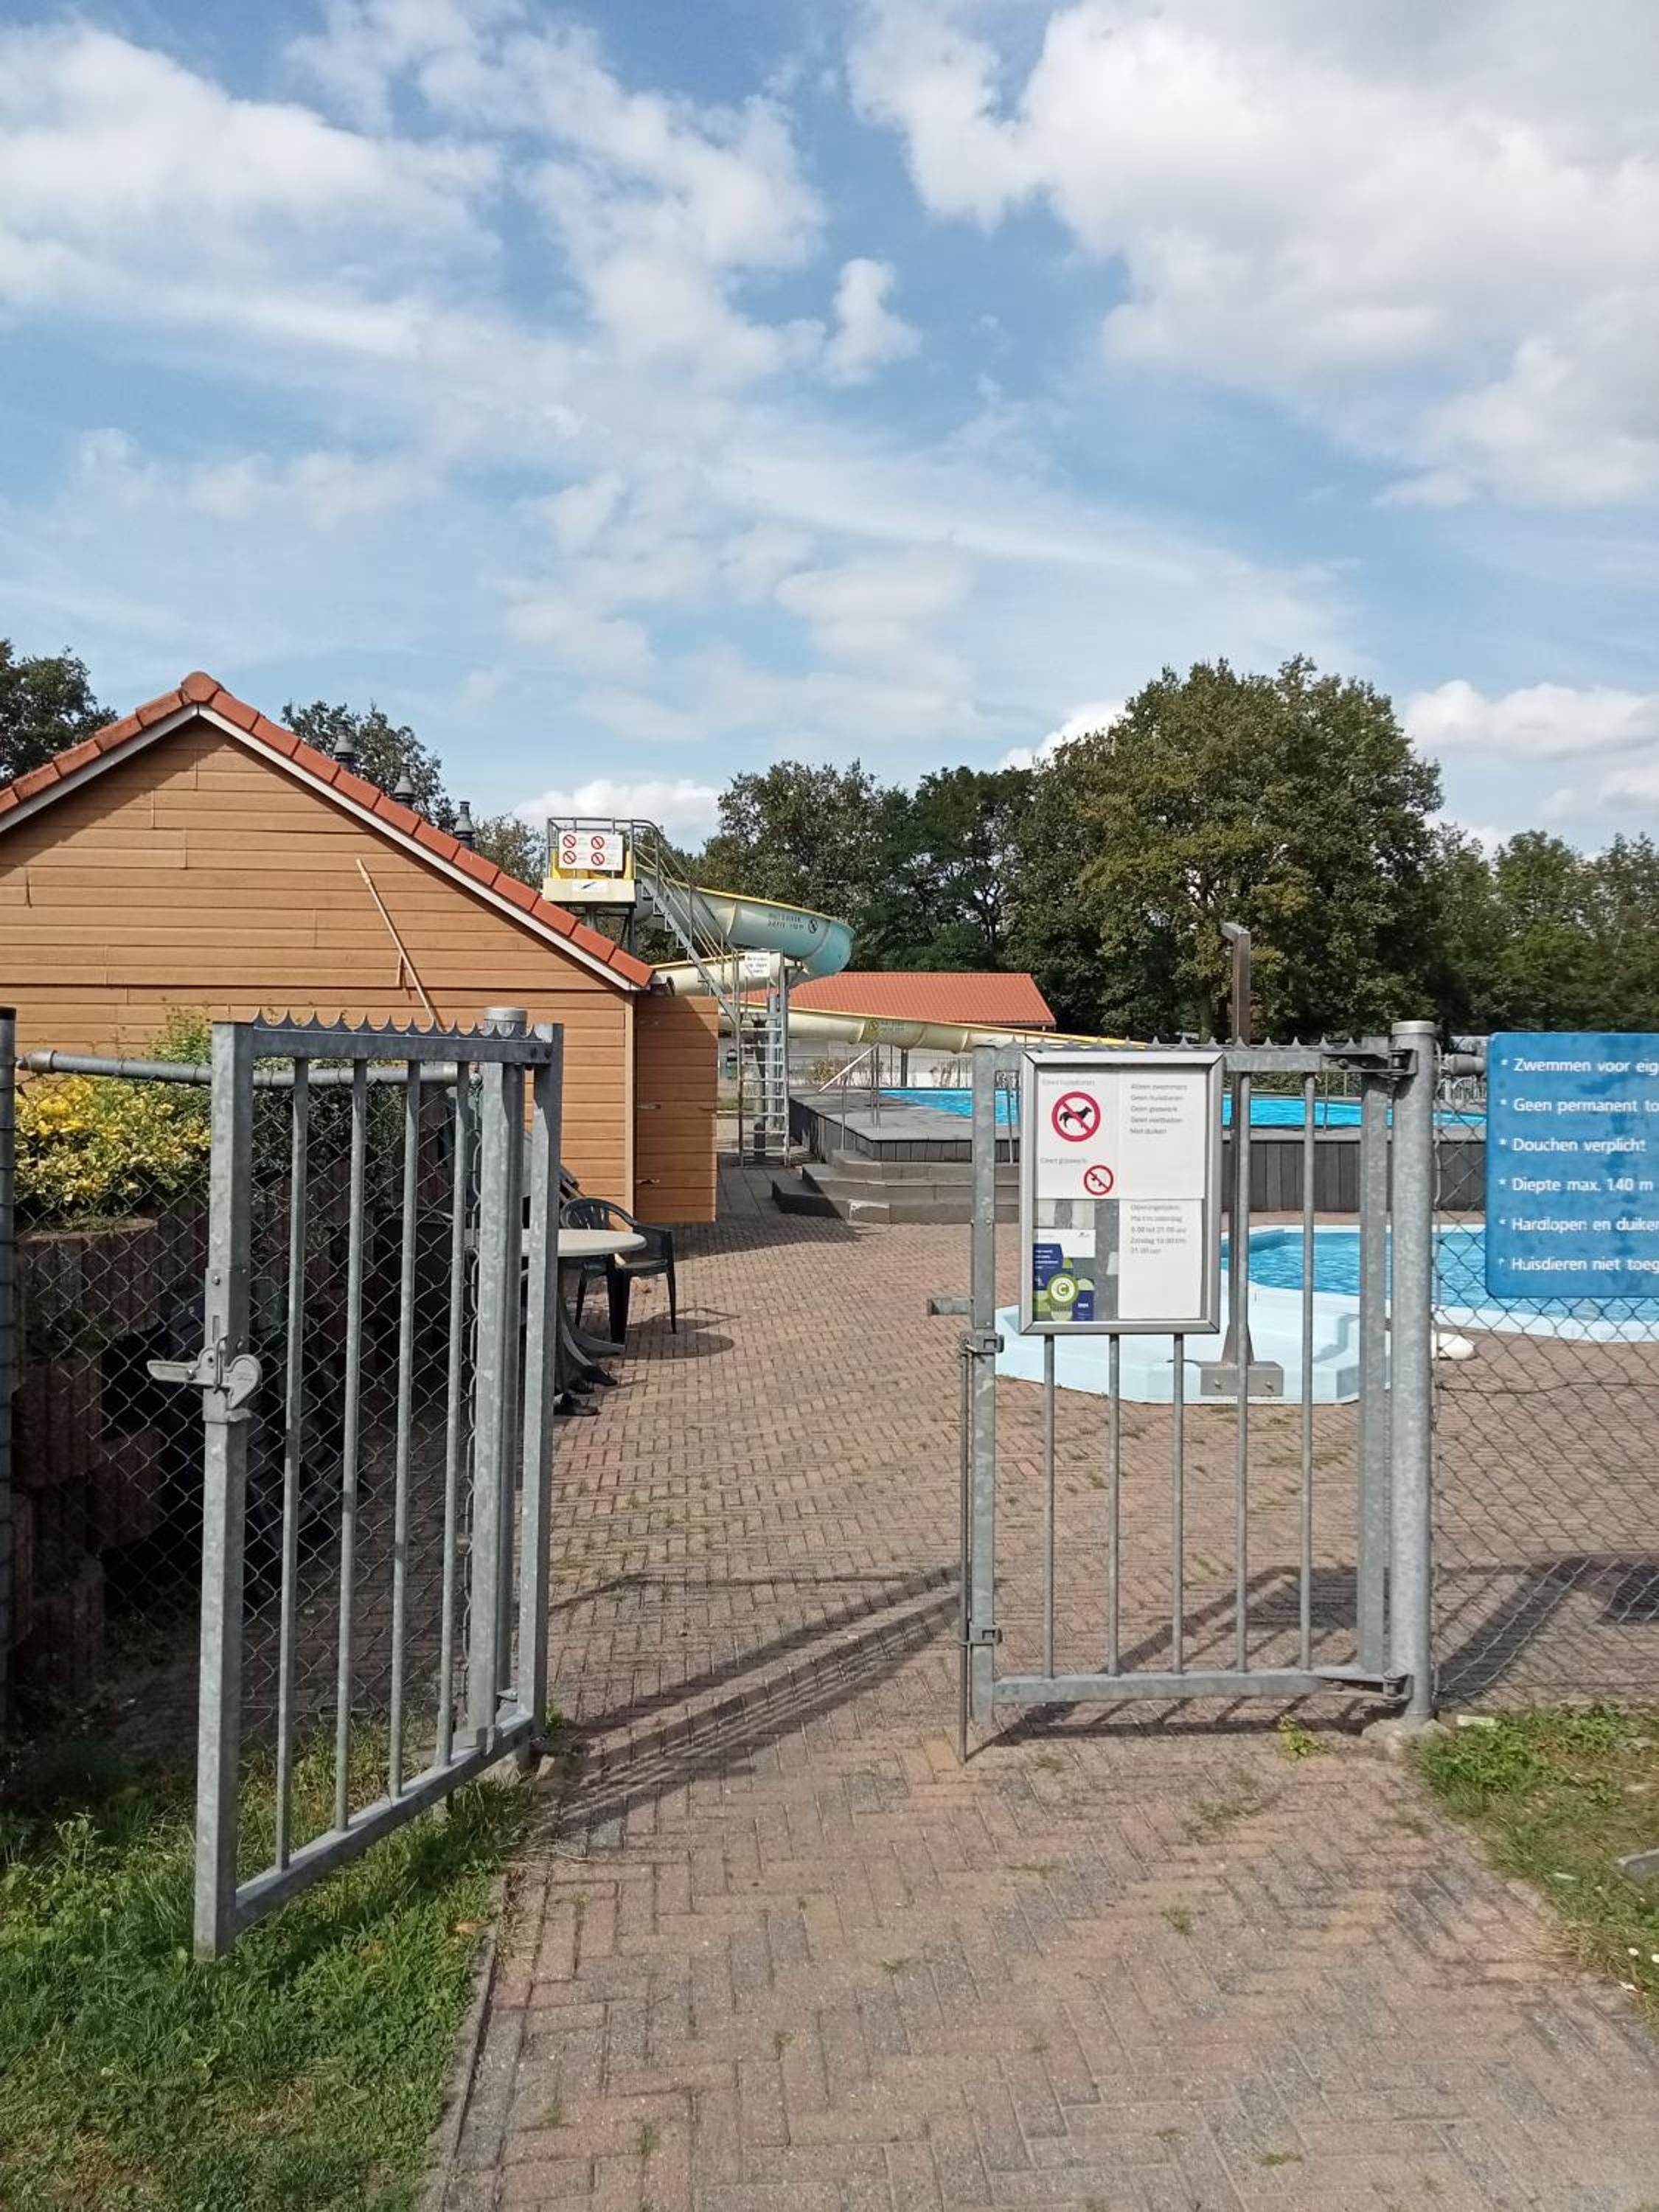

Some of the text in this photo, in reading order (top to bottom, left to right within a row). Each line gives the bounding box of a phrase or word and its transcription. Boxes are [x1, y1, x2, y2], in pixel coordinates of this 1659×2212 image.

[1513, 1057, 1659, 1077] Zwemmen voor eig
[1513, 1097, 1552, 1112] Geen
[1557, 1099, 1638, 1116] permanent
[1513, 1137, 1647, 1155] Douchen verplicht
[1512, 1176, 1562, 1194] Diepte
[1567, 1180, 1602, 1192] max.
[1638, 1180, 1654, 1192] m
[1512, 1217, 1587, 1234] Hardlopen
[1593, 1220, 1611, 1231] en
[1512, 1256, 1587, 1271] Huisdieren
[1593, 1256, 1621, 1271] niet
